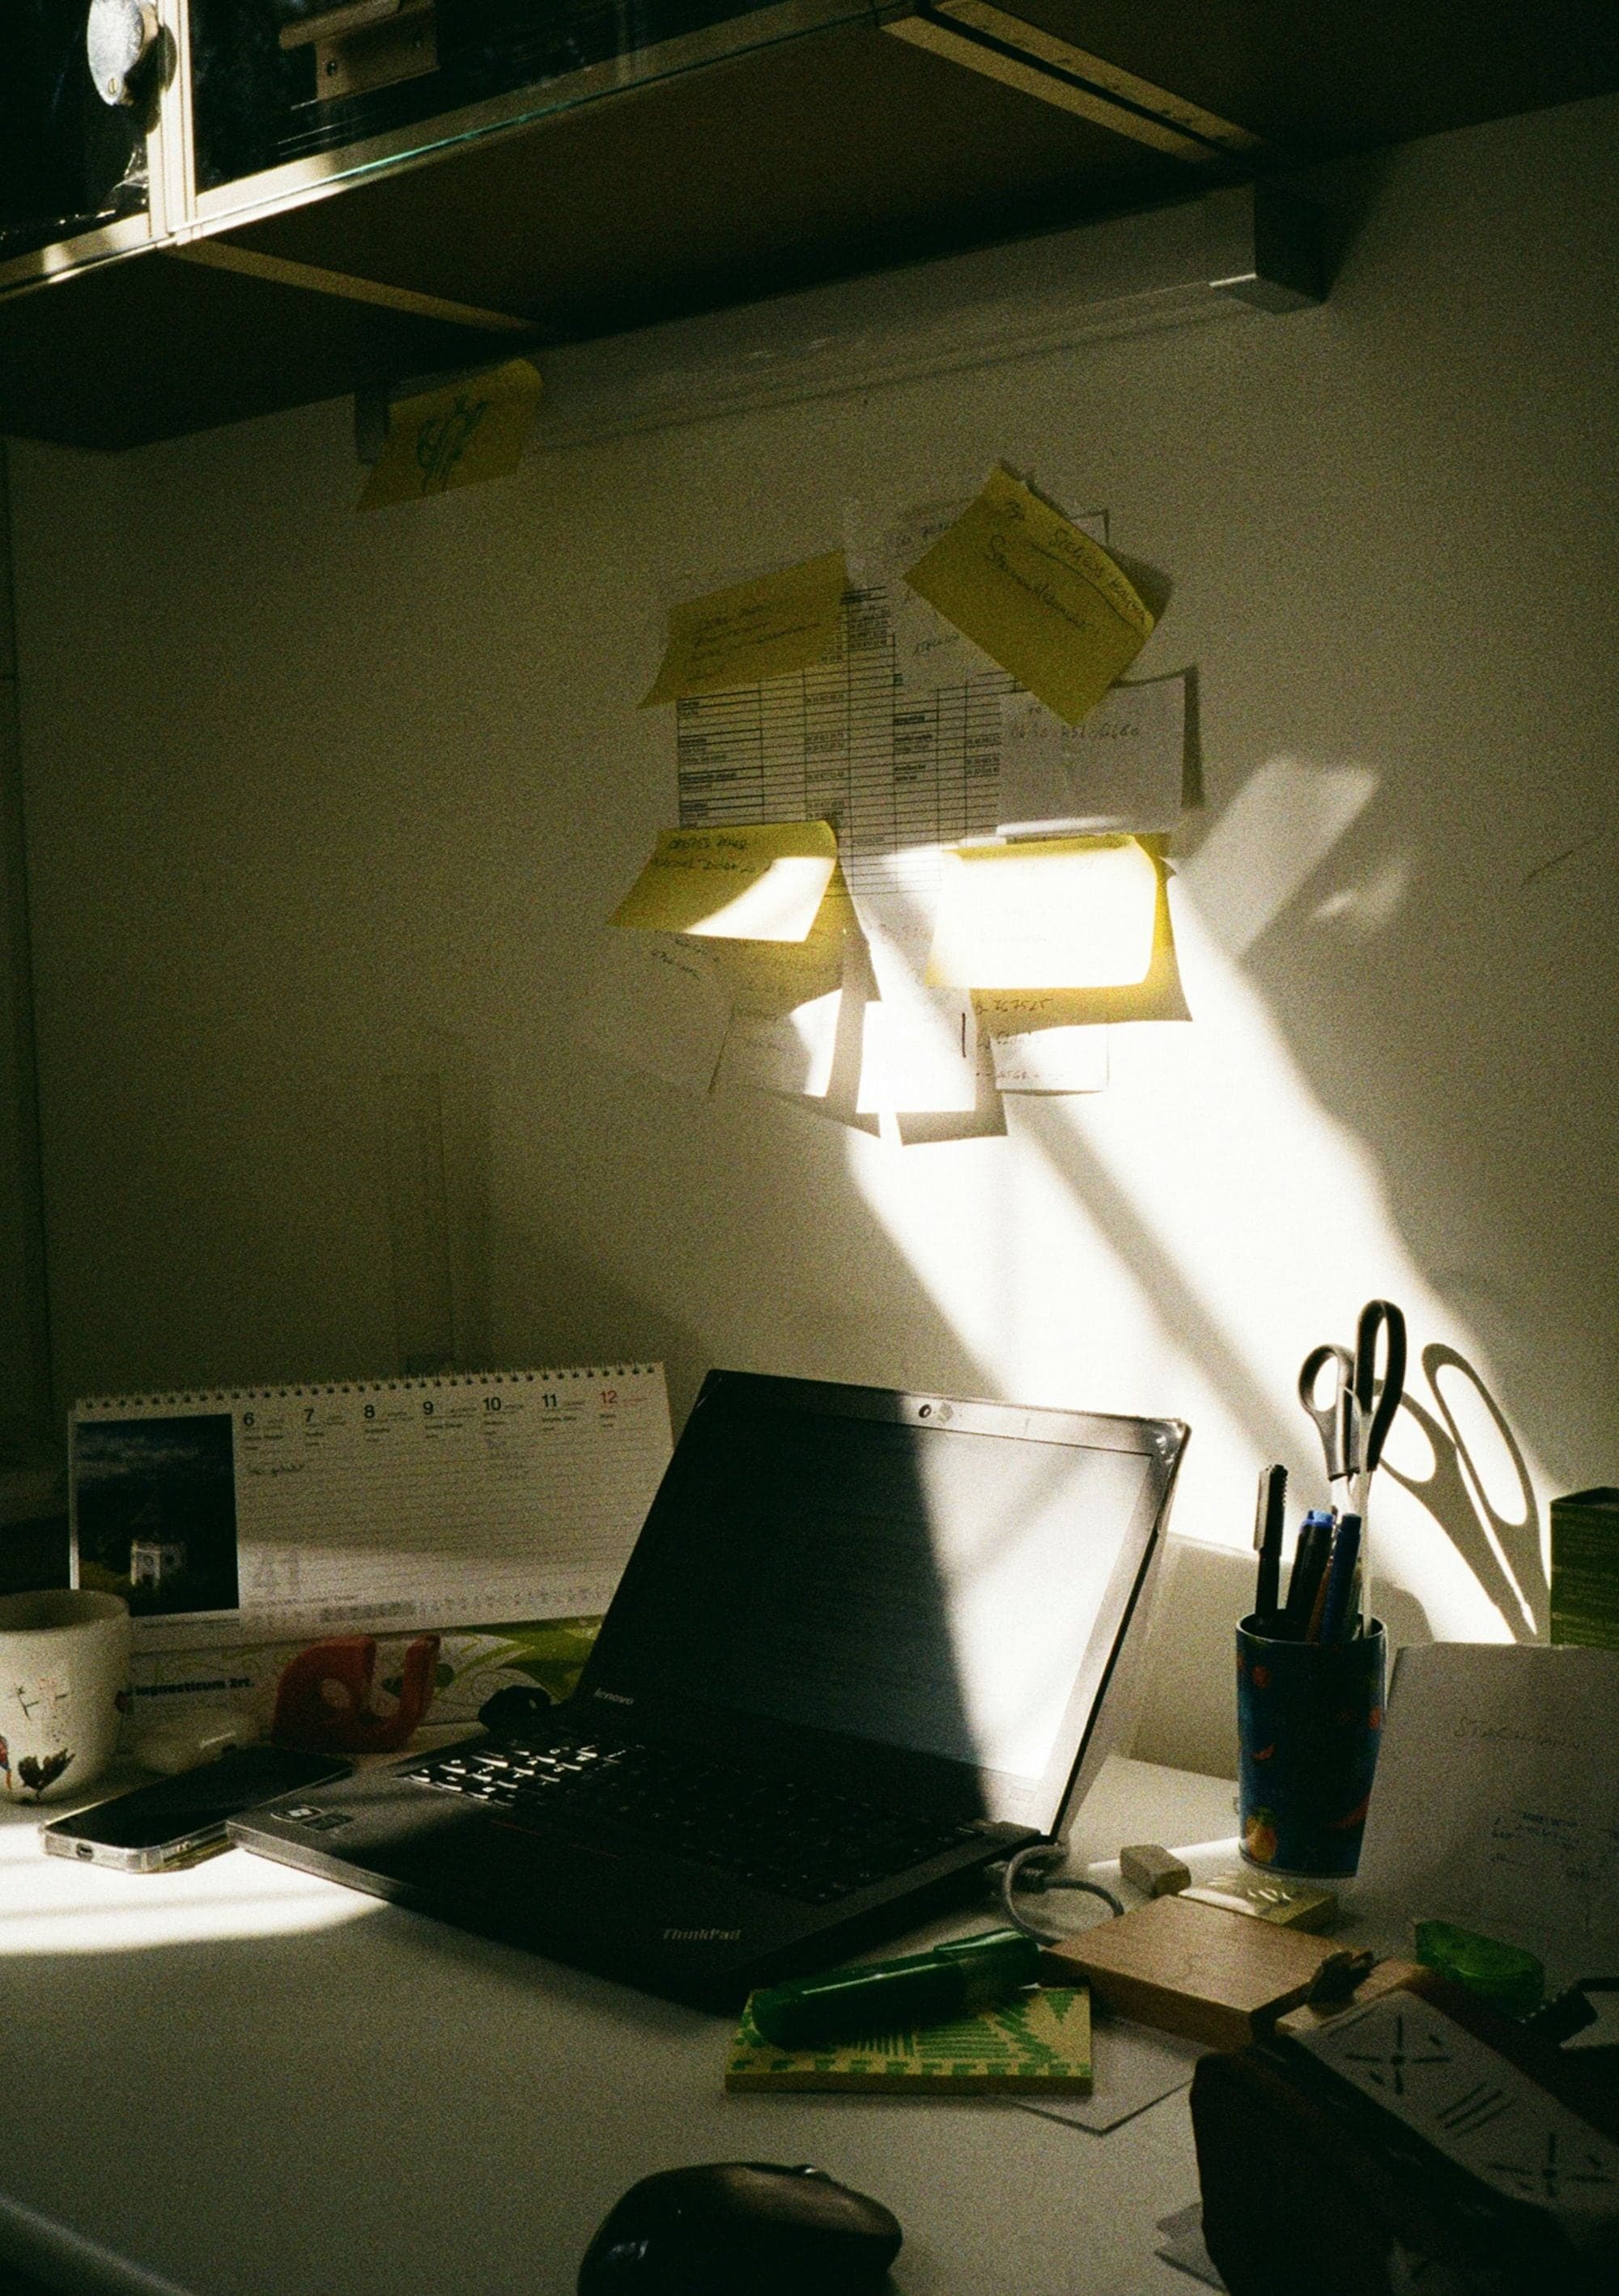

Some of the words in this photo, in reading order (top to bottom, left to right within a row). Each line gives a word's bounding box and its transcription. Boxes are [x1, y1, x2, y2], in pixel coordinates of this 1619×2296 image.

[243, 1411, 255, 1427] 6
[304, 1408, 315, 1423] 7
[363, 1404, 376, 1420] 8
[423, 1401, 434, 1415] 9
[483, 1397, 502, 1411] 10
[542, 1394, 558, 1408] 11
[600, 1390, 618, 1405] 12
[662, 1927, 742, 1941] ThinkPad
